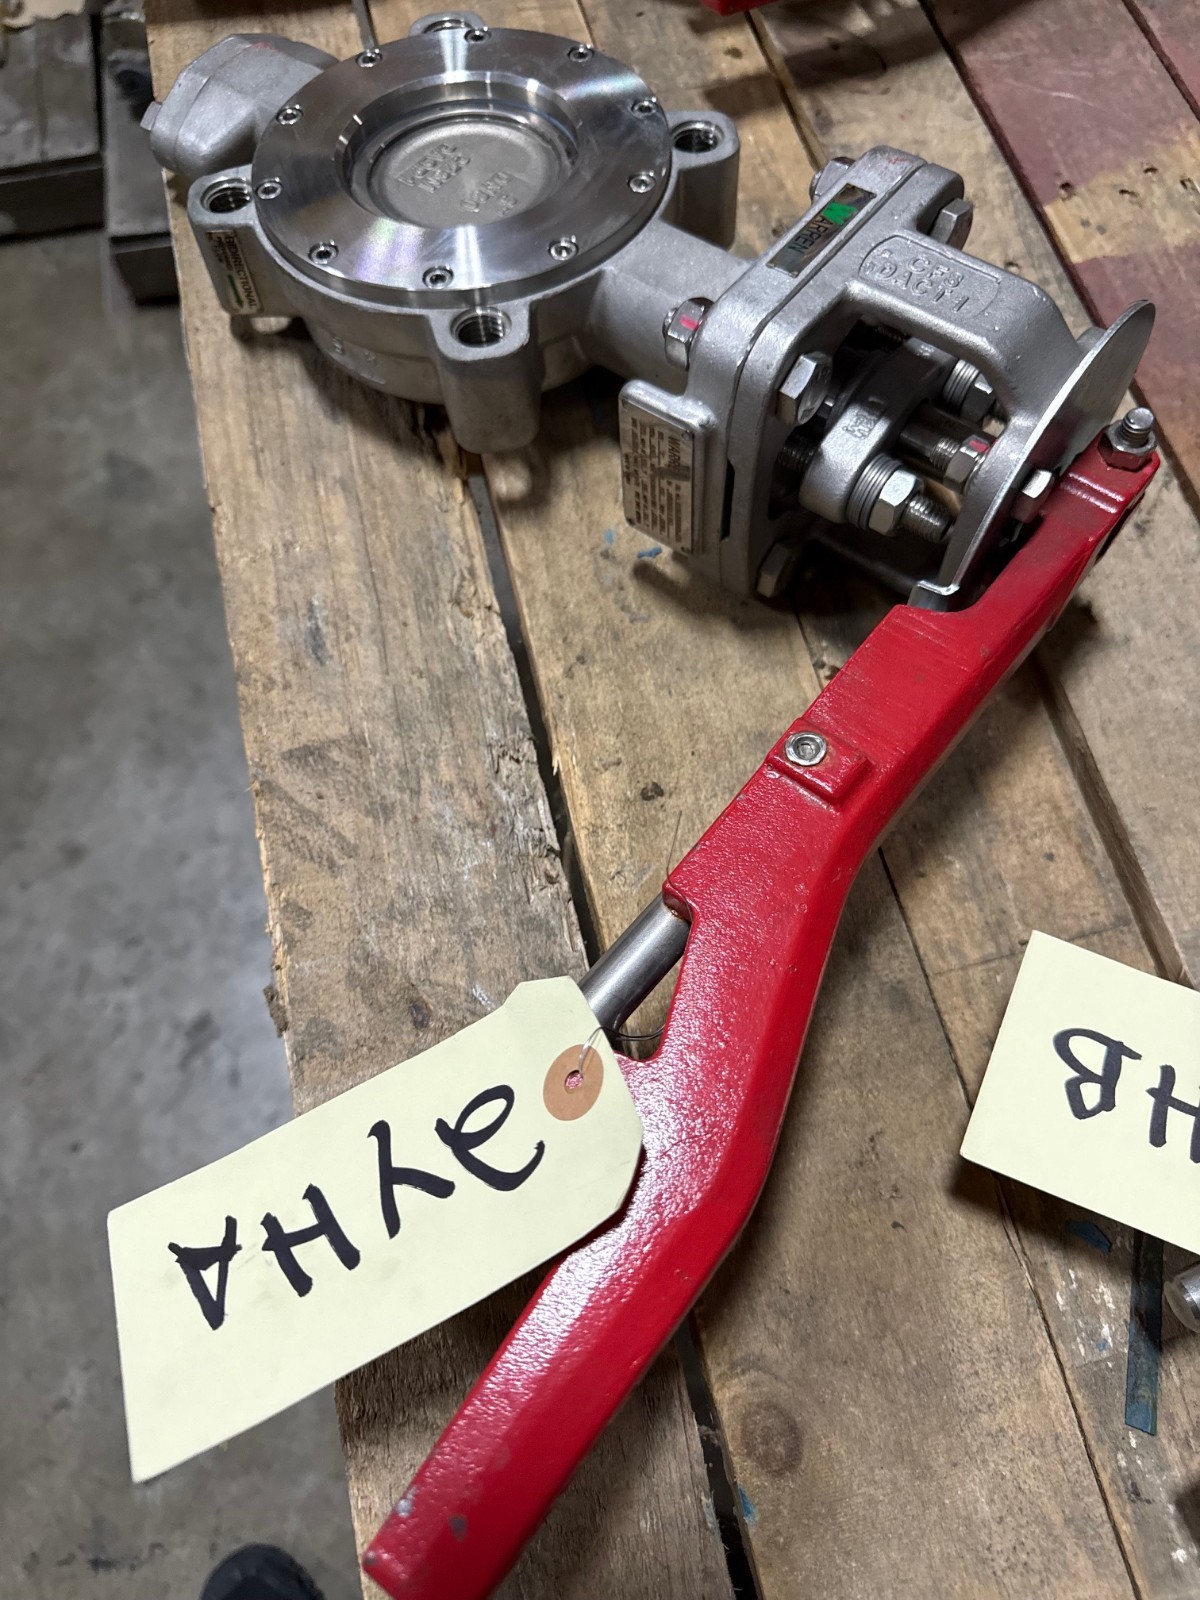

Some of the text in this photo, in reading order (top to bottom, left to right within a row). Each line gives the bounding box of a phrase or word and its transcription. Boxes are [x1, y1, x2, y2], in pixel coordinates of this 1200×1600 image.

[787, 201, 858, 255] WARREN
[225, 236, 258, 309] BIDIRECTIONAL
[907, 255, 965, 288] CF8
